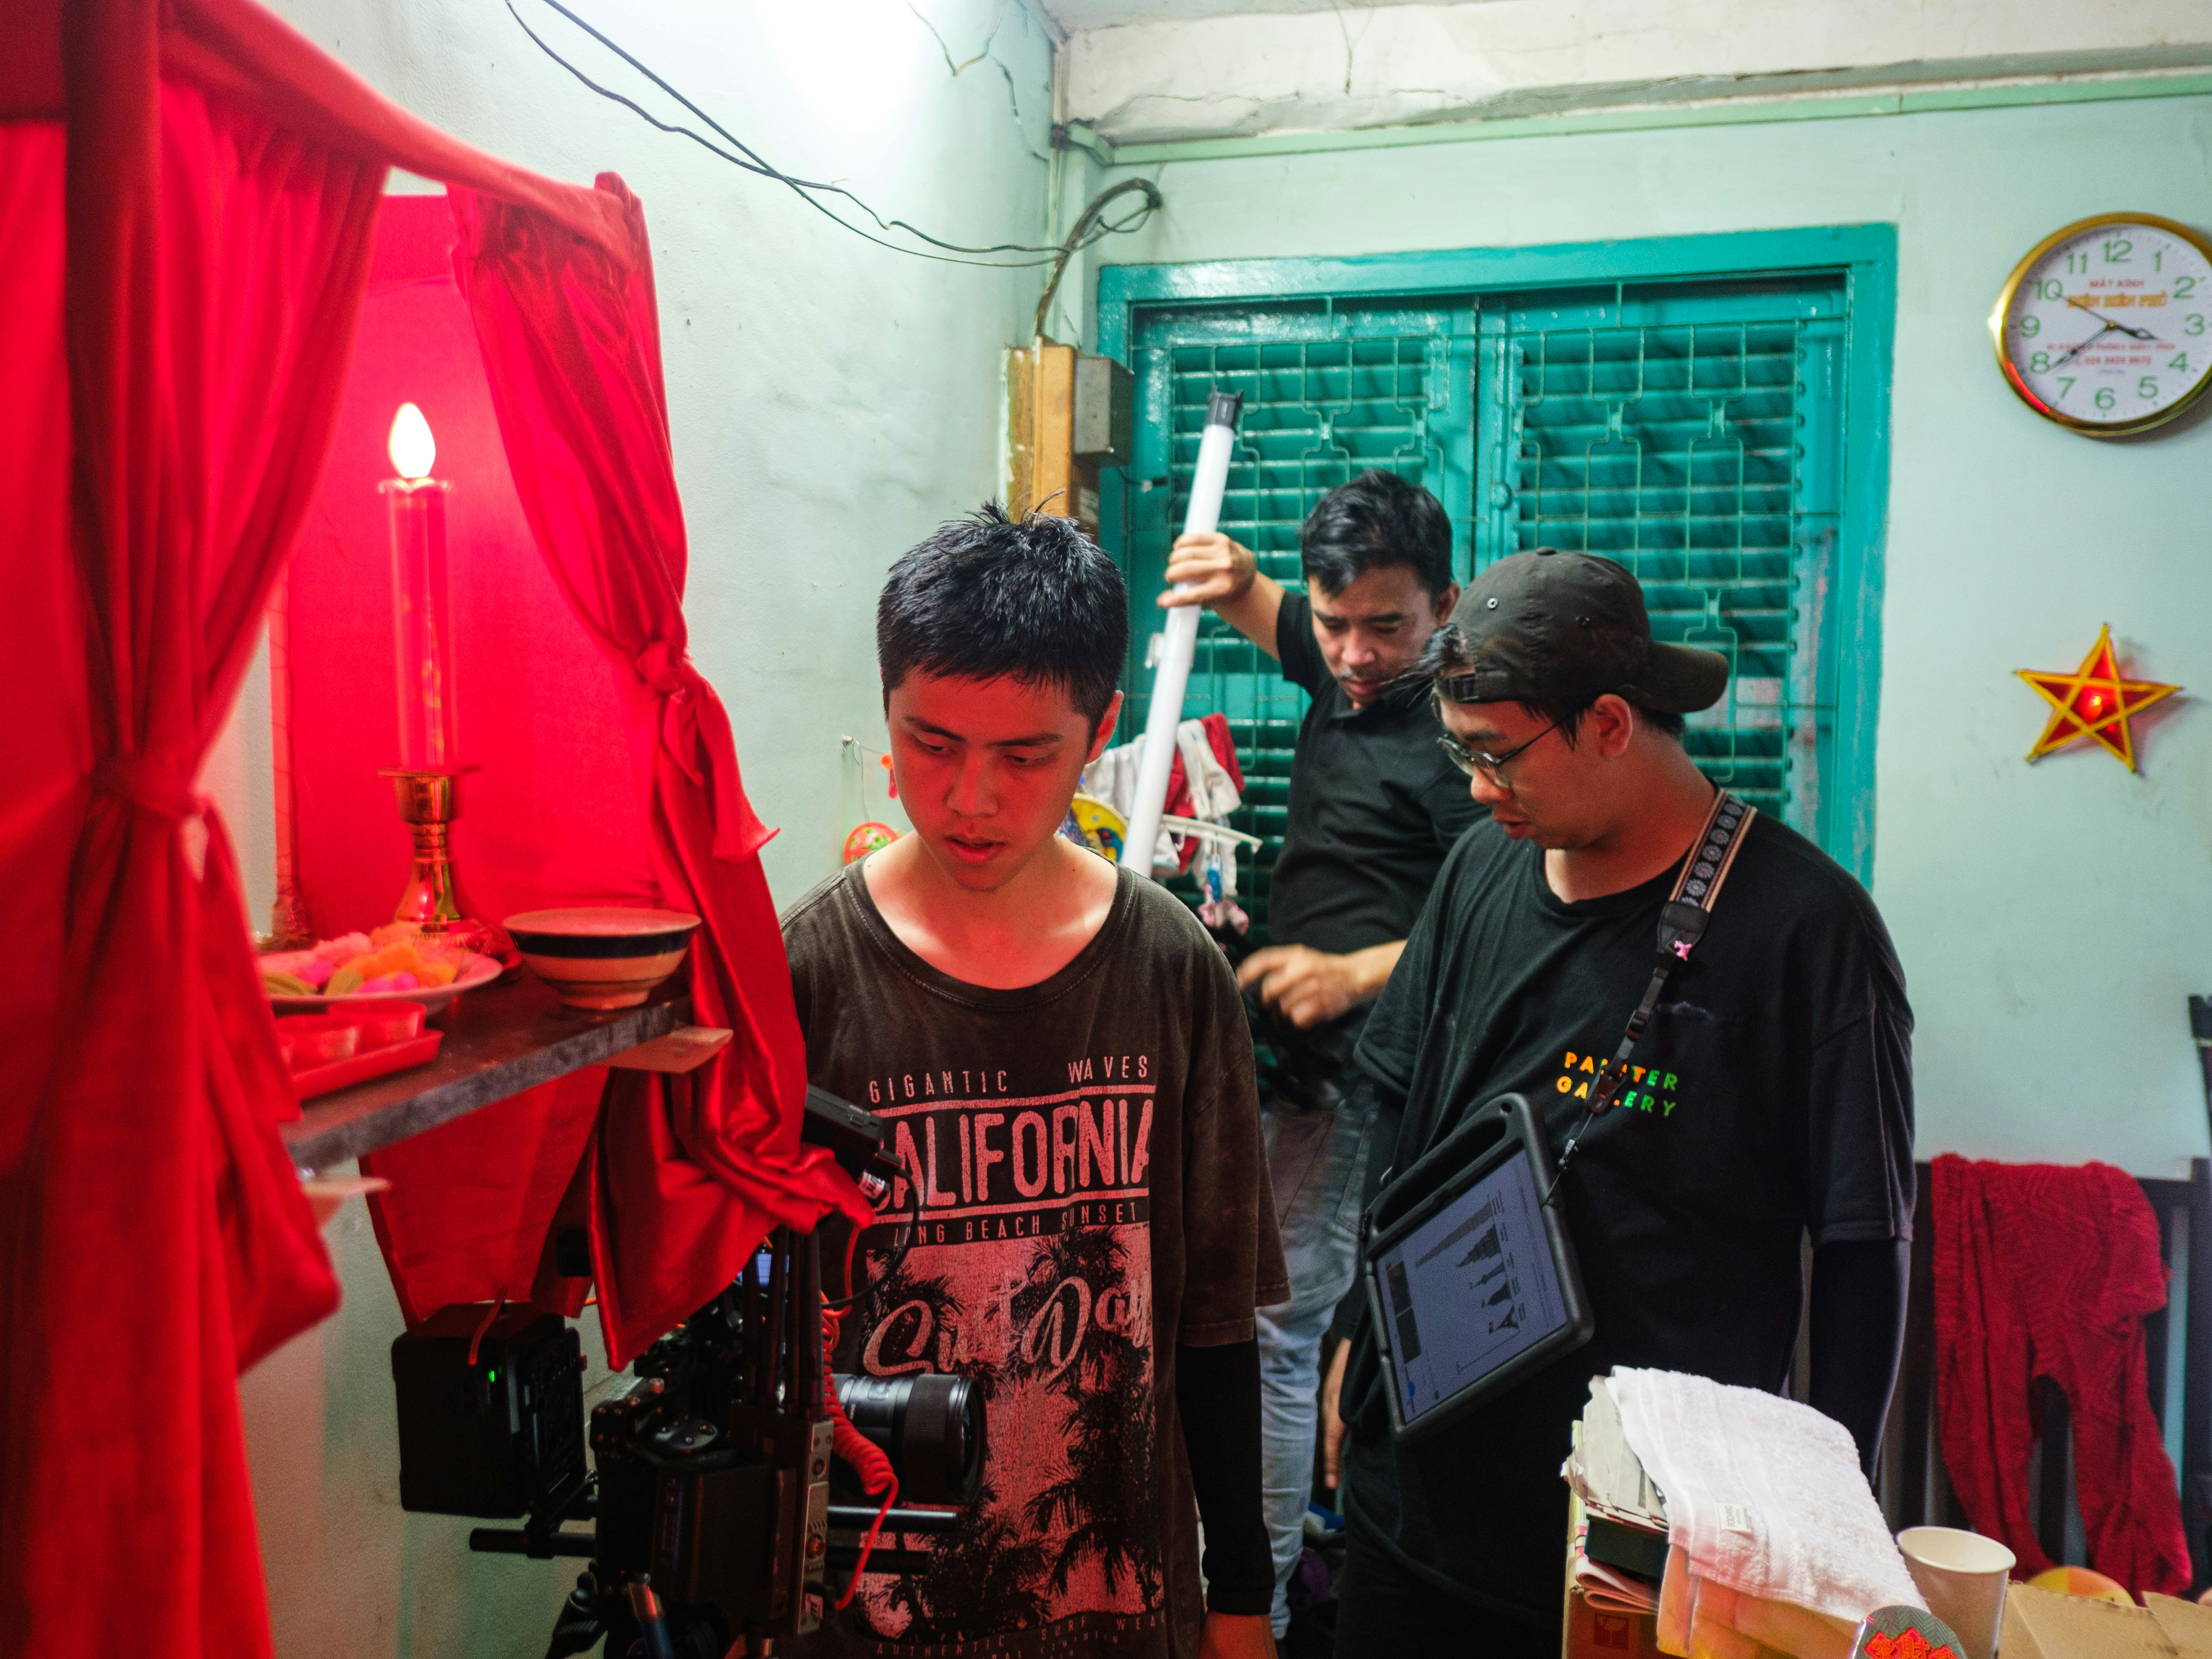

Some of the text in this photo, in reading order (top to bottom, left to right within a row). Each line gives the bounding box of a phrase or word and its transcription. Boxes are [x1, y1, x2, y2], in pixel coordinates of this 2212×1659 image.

[2104, 240, 2132, 262] 12
[2153, 250, 2161, 272] 1
[2066, 252, 2088, 274] 11
[2035, 279, 2062, 300] 10
[2173, 276, 2195, 299] 2
[2019, 315, 2040, 338] 9
[2184, 313, 2205, 335] 3
[2029, 351, 2049, 374] 8
[2168, 352, 2188, 372] 4
[2056, 376, 2076, 398] 7
[2138, 376, 2157, 398] 5
[2094, 388, 2115, 410] 6
[869, 1055, 1147, 1103] GIGANTIC WAVES
[1557, 1076, 1676, 1116] GAERY
[871, 1099, 1153, 1211] ALIFORNI
[966, 1216, 1039, 1241] BEACH
[1062, 1202, 1137, 1228] SUNSET
[877, 1635, 1004, 1657] AUTHENTIC
[1041, 1615, 1085, 1641] SURF
